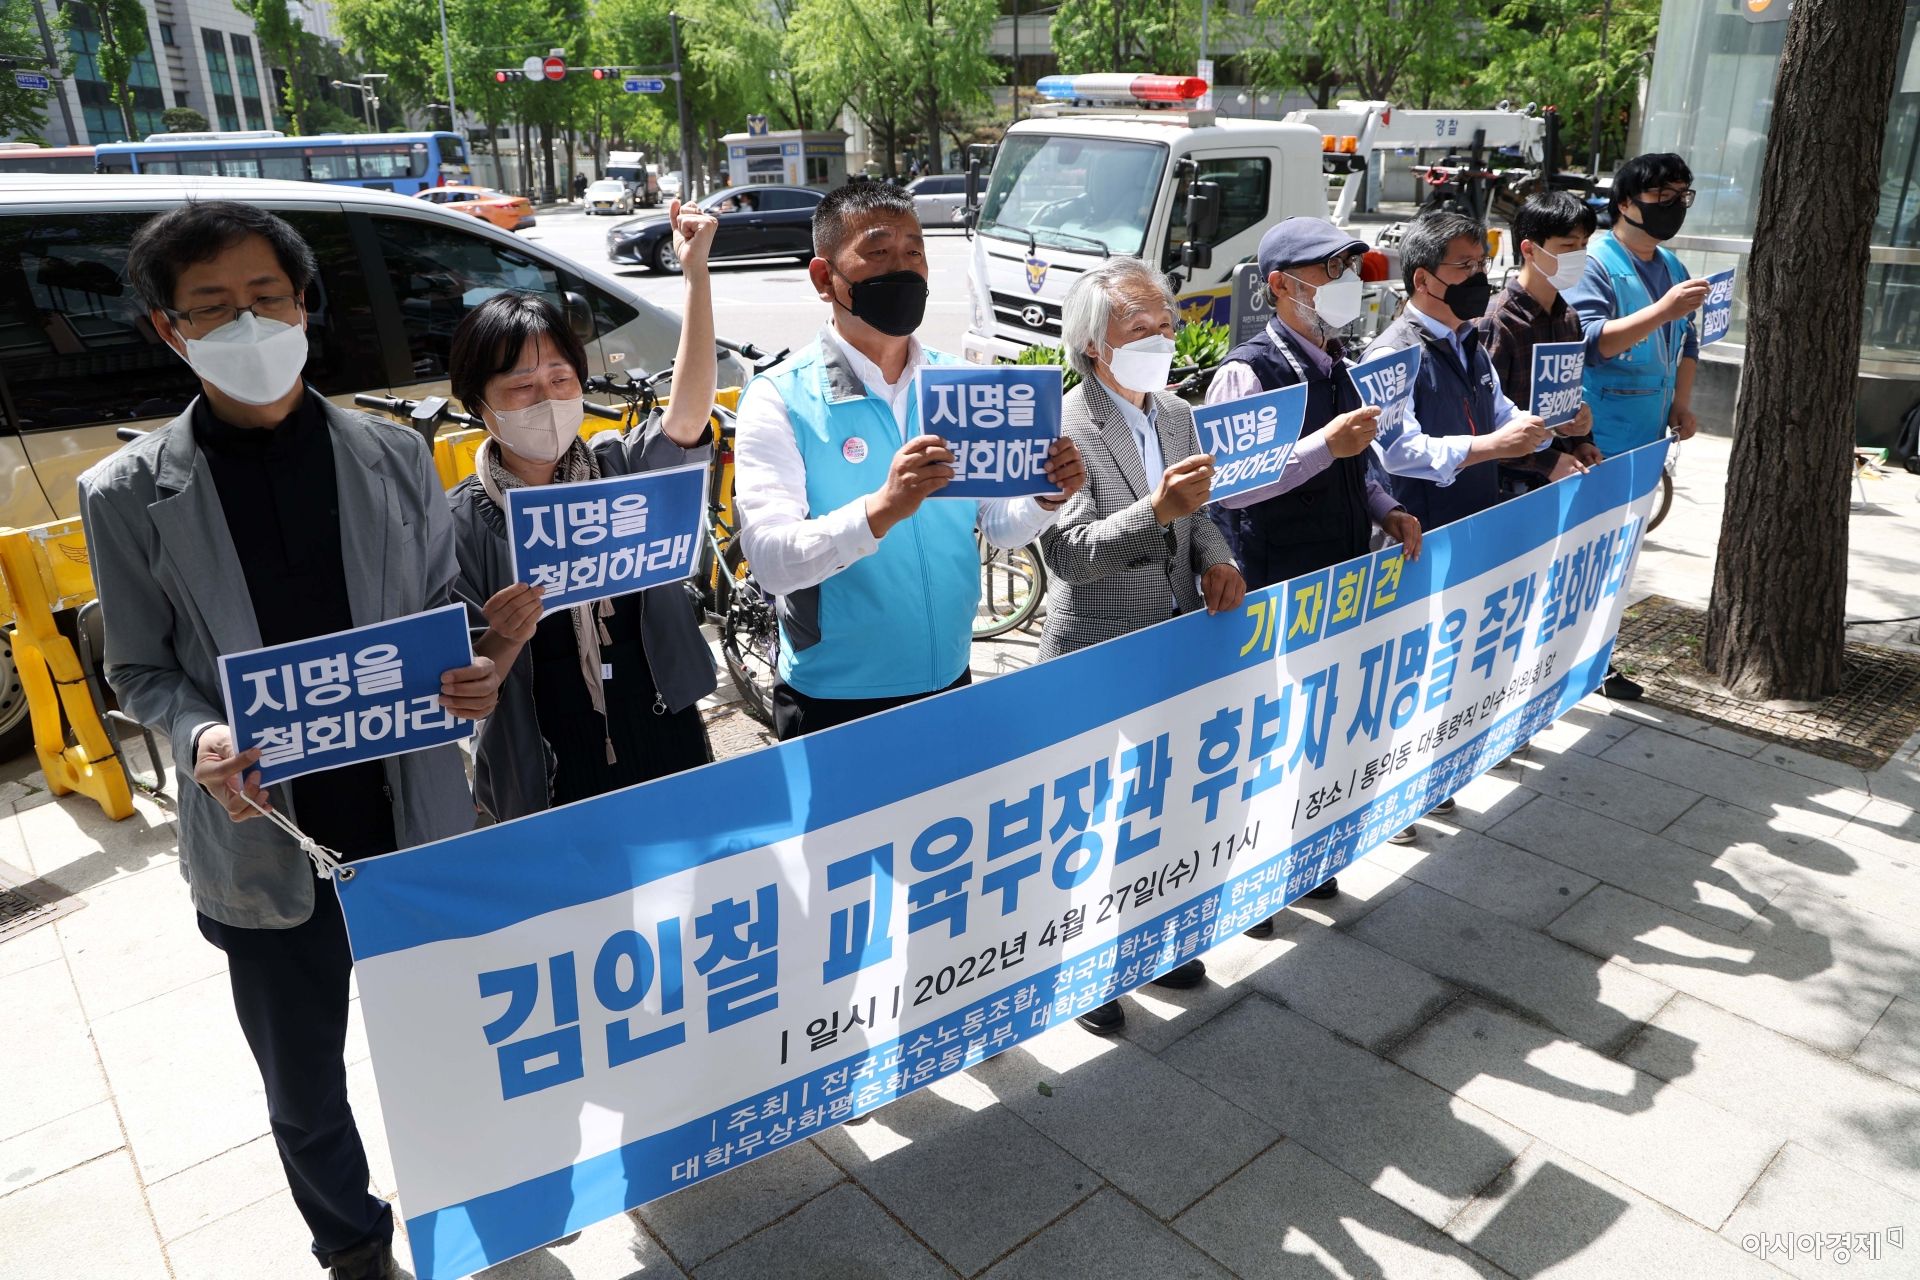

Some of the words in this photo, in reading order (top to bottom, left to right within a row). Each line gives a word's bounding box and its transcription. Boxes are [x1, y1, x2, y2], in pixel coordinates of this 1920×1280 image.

[1435, 118, 1459, 136] 경찰
[1359, 363, 1407, 404] 지명을
[1538, 352, 1585, 383] 지명을
[930, 384, 1036, 428] 지명을
[1203, 406, 1278, 455] 지명을
[522, 493, 649, 549] 지명을
[529, 534, 692, 599] 철회하라!
[1240, 554, 1404, 657] 기자회견
[242, 643, 403, 716] 지명을
[478, 883, 779, 1101] 김인철
[823, 732, 1173, 985] 교육부장관
[1192, 662, 1340, 824] 후보자
[1347, 608, 1467, 746] 지명을
[1471, 571, 1537, 680] 즉각
[806, 996, 876, 1052] 일시
[913, 931, 1027, 1006] 2022년
[1038, 904, 1086, 946] 4월
[1096, 851, 1199, 924] 27일(수)
[1211, 820, 1260, 867] 11시
[1305, 780, 1342, 819] 장소
[1361, 740, 1412, 790] 통의동
[1418, 702, 1478, 753] 대통령직
[1480, 660, 1543, 719] 인수위원회
[1544, 651, 1557, 678] 앞
[727, 1091, 789, 1132] 주최
[821, 984, 1040, 1096] 전국교수노동조합,
[1052, 894, 1222, 994] 전국대학노동조합,
[671, 1022, 1019, 1181] 대학무상화평준화운동본부,
